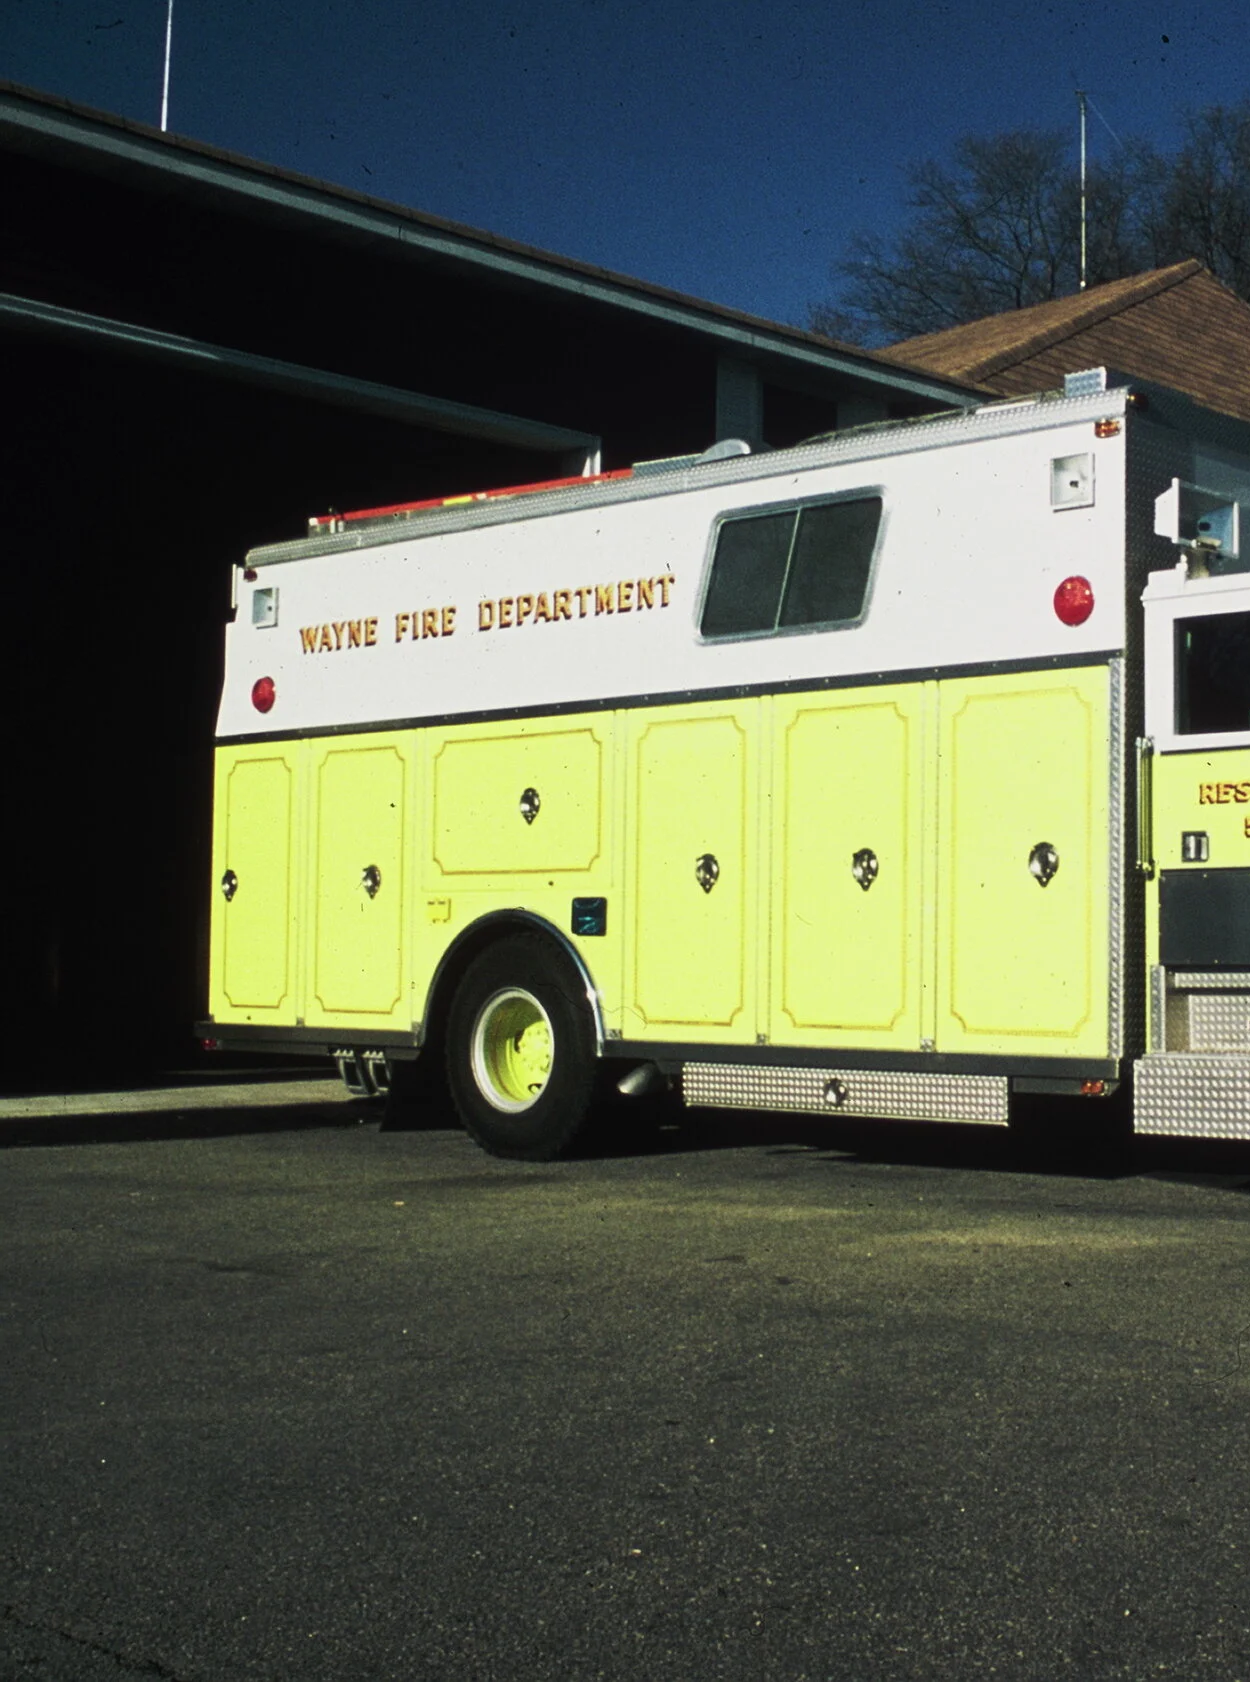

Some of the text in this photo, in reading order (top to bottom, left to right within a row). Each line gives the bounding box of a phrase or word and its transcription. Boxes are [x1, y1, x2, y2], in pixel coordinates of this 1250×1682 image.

[299, 573, 675, 655] WAYNE FIRE DEPARTMENT
